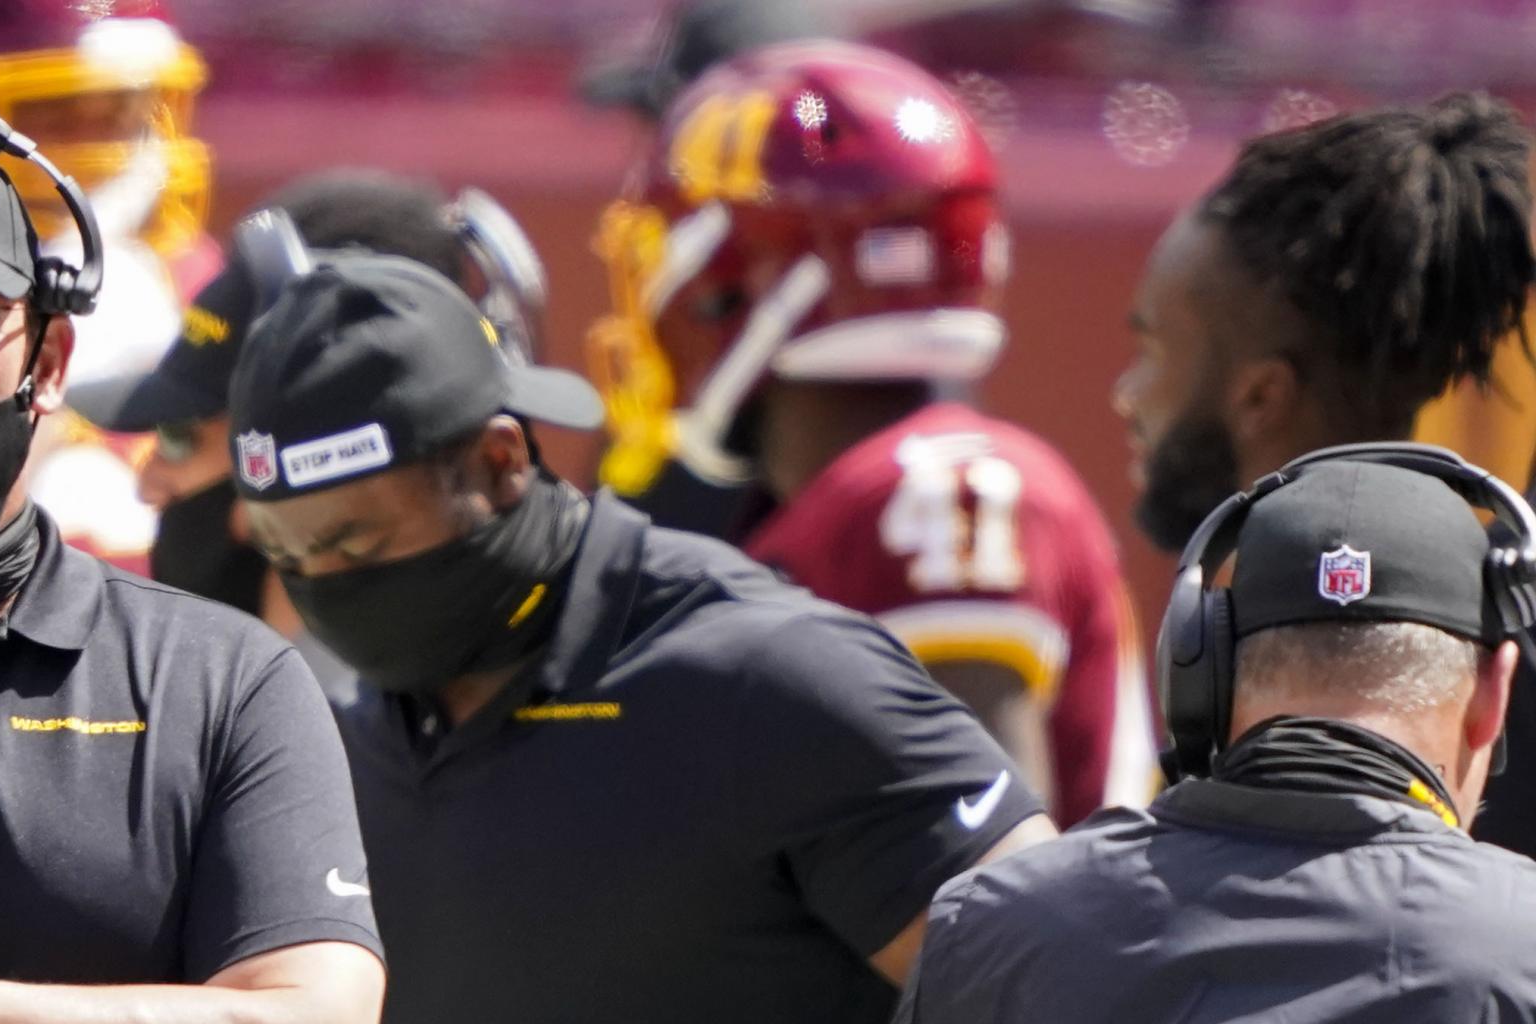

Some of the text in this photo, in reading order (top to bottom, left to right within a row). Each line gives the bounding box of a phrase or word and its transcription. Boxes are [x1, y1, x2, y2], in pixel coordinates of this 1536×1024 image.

[291, 453, 331, 473] STOP
[876, 430, 1026, 594] 41
[1326, 570, 1364, 594] NFL
[10, 716, 146, 734] WASHINGTON
